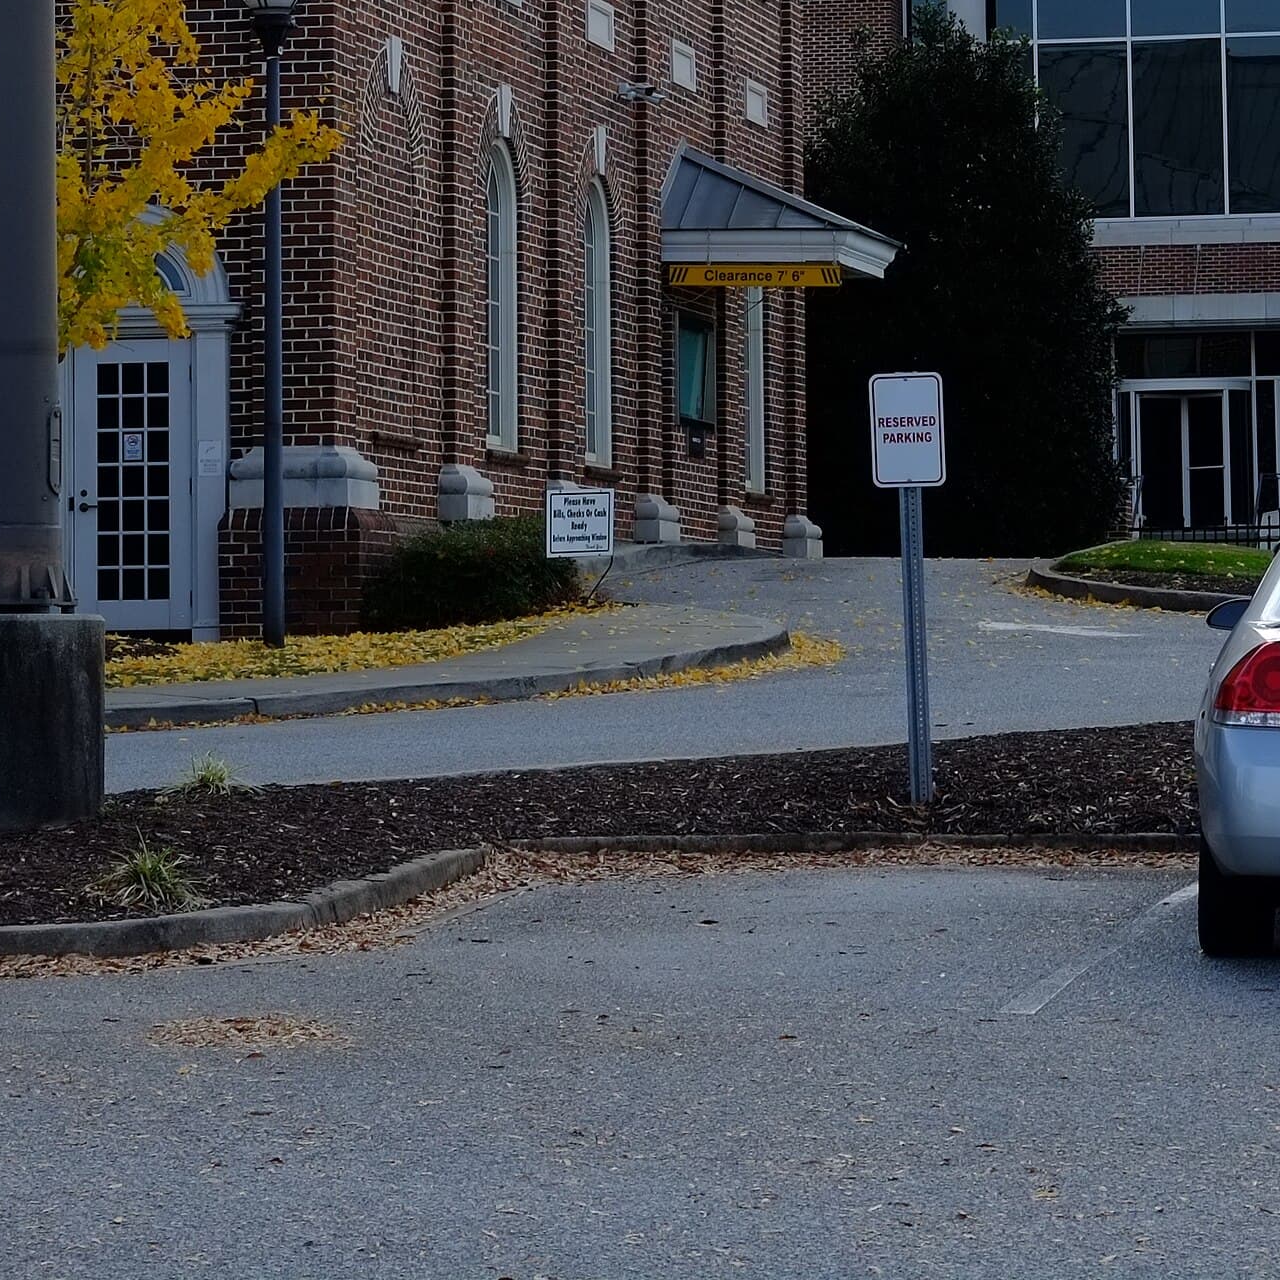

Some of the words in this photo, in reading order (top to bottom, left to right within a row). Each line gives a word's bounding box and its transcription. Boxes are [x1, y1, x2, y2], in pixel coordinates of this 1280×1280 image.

[704, 270, 772, 282] Clearance
[777, 270, 788, 282] 7'
[878, 416, 936, 428] RESERVED
[883, 432, 932, 444] PARKING
[563, 497, 581, 506] Please
[582, 496, 596, 506] Have
[553, 509, 566, 519] Bills,
[566, 508, 585, 518] Checks
[585, 508, 593, 517] Or
[594, 507, 607, 518] Cash
[571, 521, 587, 532] Ready
[566, 533, 591, 544] Approaching
